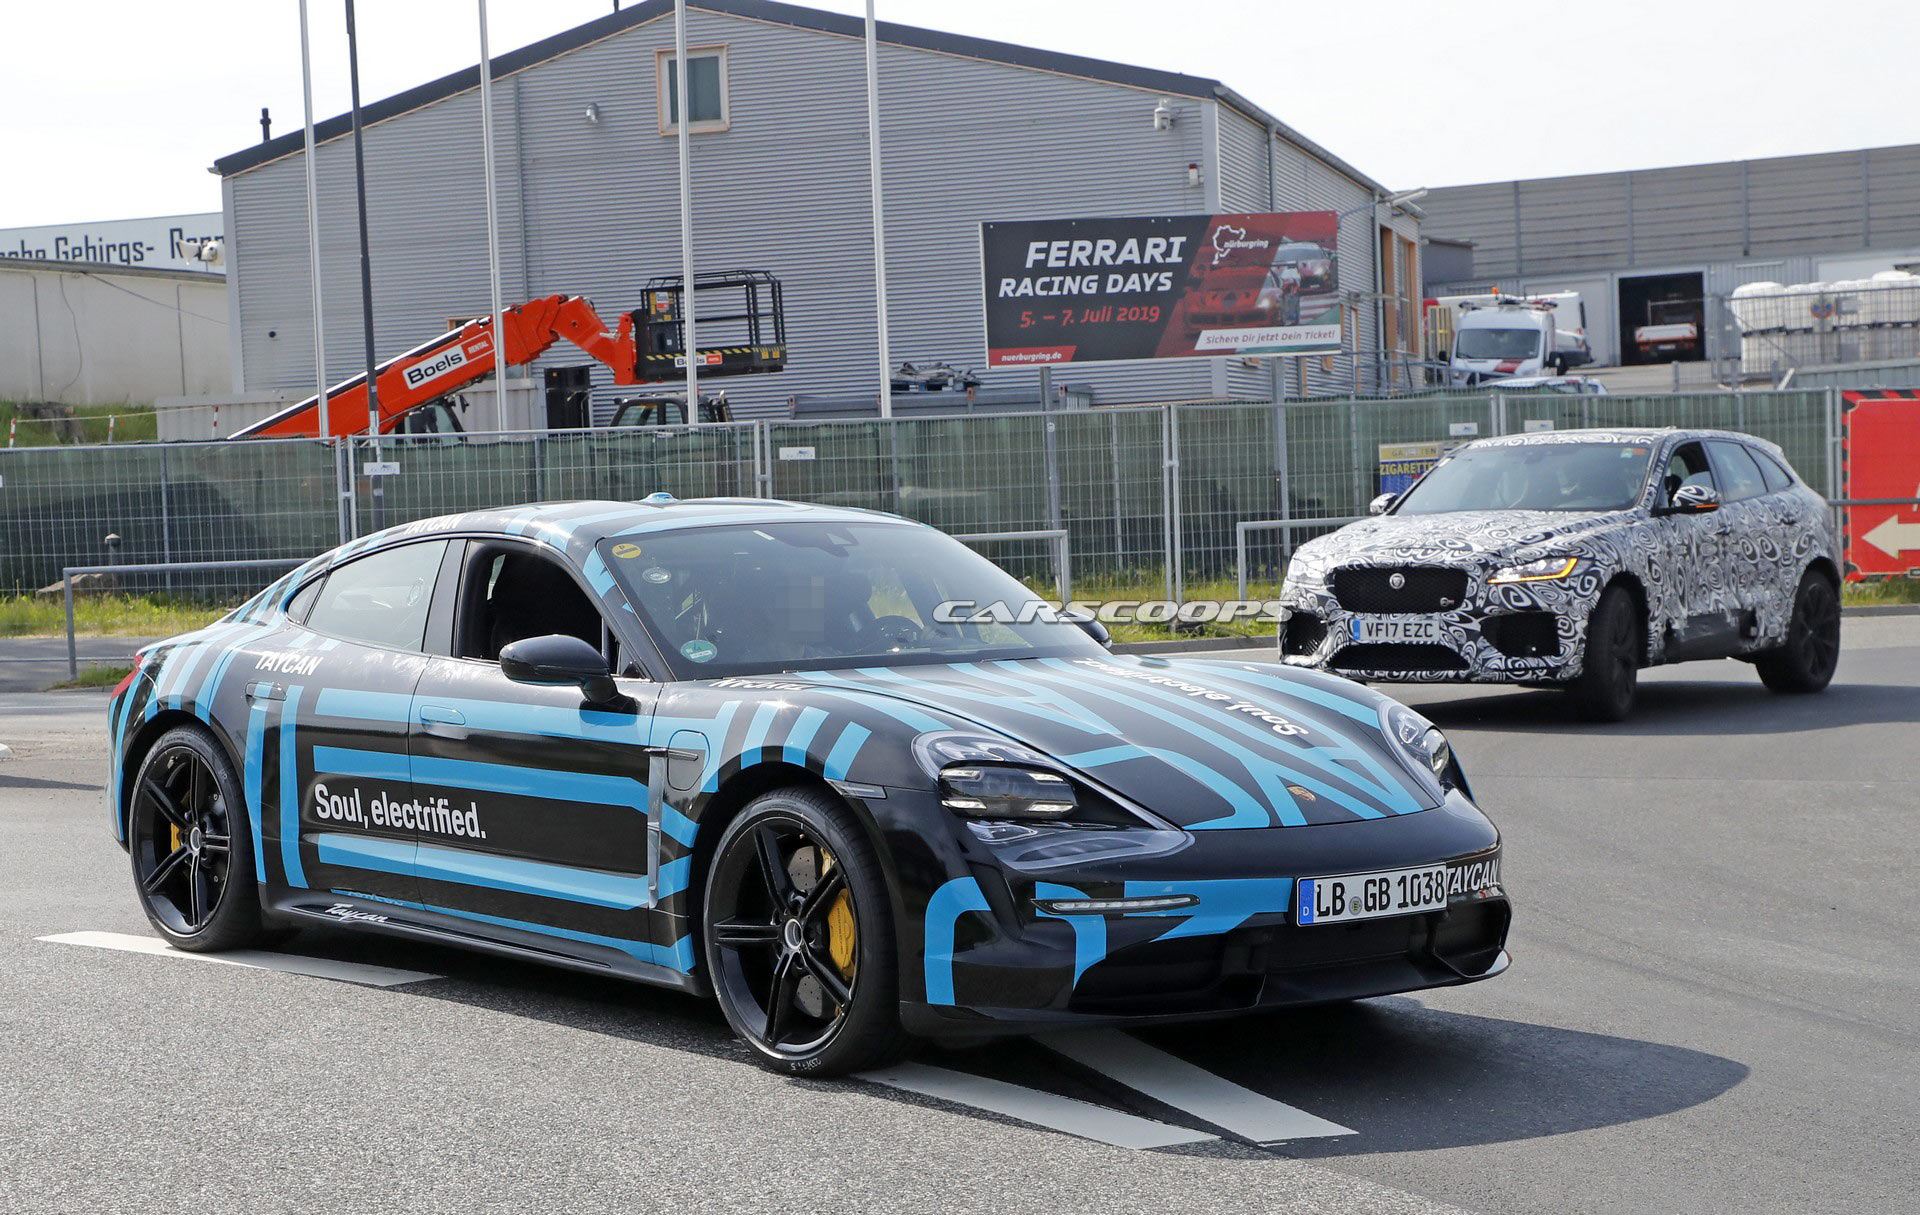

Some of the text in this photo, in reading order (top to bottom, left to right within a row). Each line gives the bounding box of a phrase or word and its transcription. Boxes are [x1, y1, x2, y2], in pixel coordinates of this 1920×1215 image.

[1025, 236, 1187, 268] FERRARI
[999, 272, 1173, 298] RACING DAYS
[1020, 311, 1036, 328] 5.
[1062, 309, 1074, 326] 7.
[1080, 306, 1113, 323] Juli
[1117, 306, 1160, 323] 2019
[1206, 330, 1336, 344] Sichere Dir jetzt Dein Ticket!
[407, 353, 463, 385] Boels
[676, 356, 705, 366] Bls
[1001, 351, 1062, 362] nuerburgring.de
[1366, 622, 1433, 638] VF17 EZC
[254, 650, 325, 676] TAYCAN
[1225, 700, 1309, 736] Soul,
[314, 783, 487, 839] Soul, electrified.
[1446, 858, 1499, 894] TAYCAN
[1302, 870, 1445, 917] D LB GB 1038
[324, 902, 389, 923] Taycan
